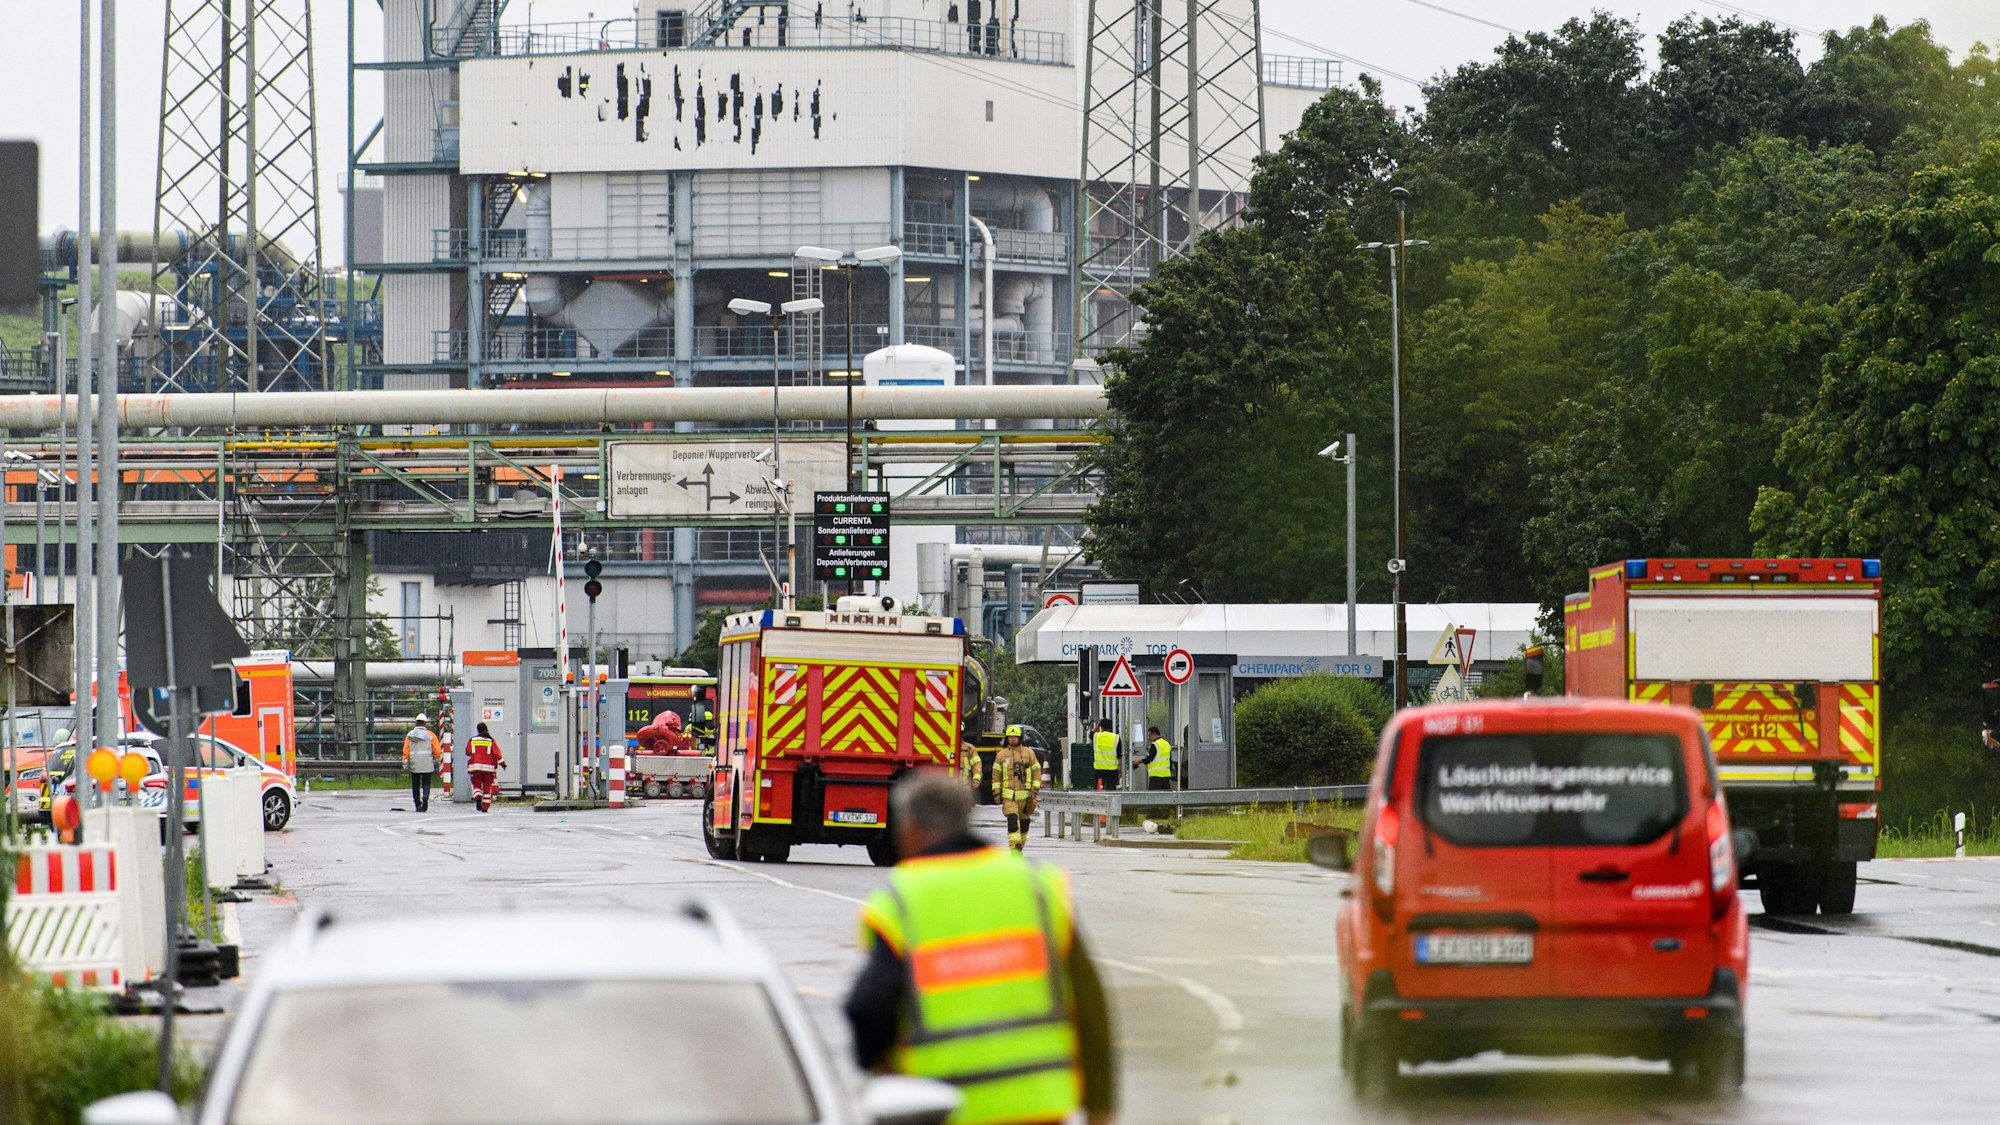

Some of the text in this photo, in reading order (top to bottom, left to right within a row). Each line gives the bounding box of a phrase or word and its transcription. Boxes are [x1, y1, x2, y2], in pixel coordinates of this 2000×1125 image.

[616, 470, 677, 483] Verbrennungs-
[617, 484, 648, 497] anlagen
[817, 494, 888, 504] Produktanlieferungen
[833, 516, 873, 525] CURRENTA
[817, 526, 887, 536] Sonderanlieferungen
[829, 548, 876, 558] Anlieferungen
[816, 558, 888, 568] Deponie/Verbrennung
[1146, 644, 1168, 655] TOR
[1238, 663, 1372, 675] CHEMPARK TOR 9
[628, 709, 649, 721] 112
[1750, 722, 1777, 738] 112
[1438, 762, 1674, 790] Löschanlagenservice
[1438, 789, 1609, 814] Werkfeuerwehr
